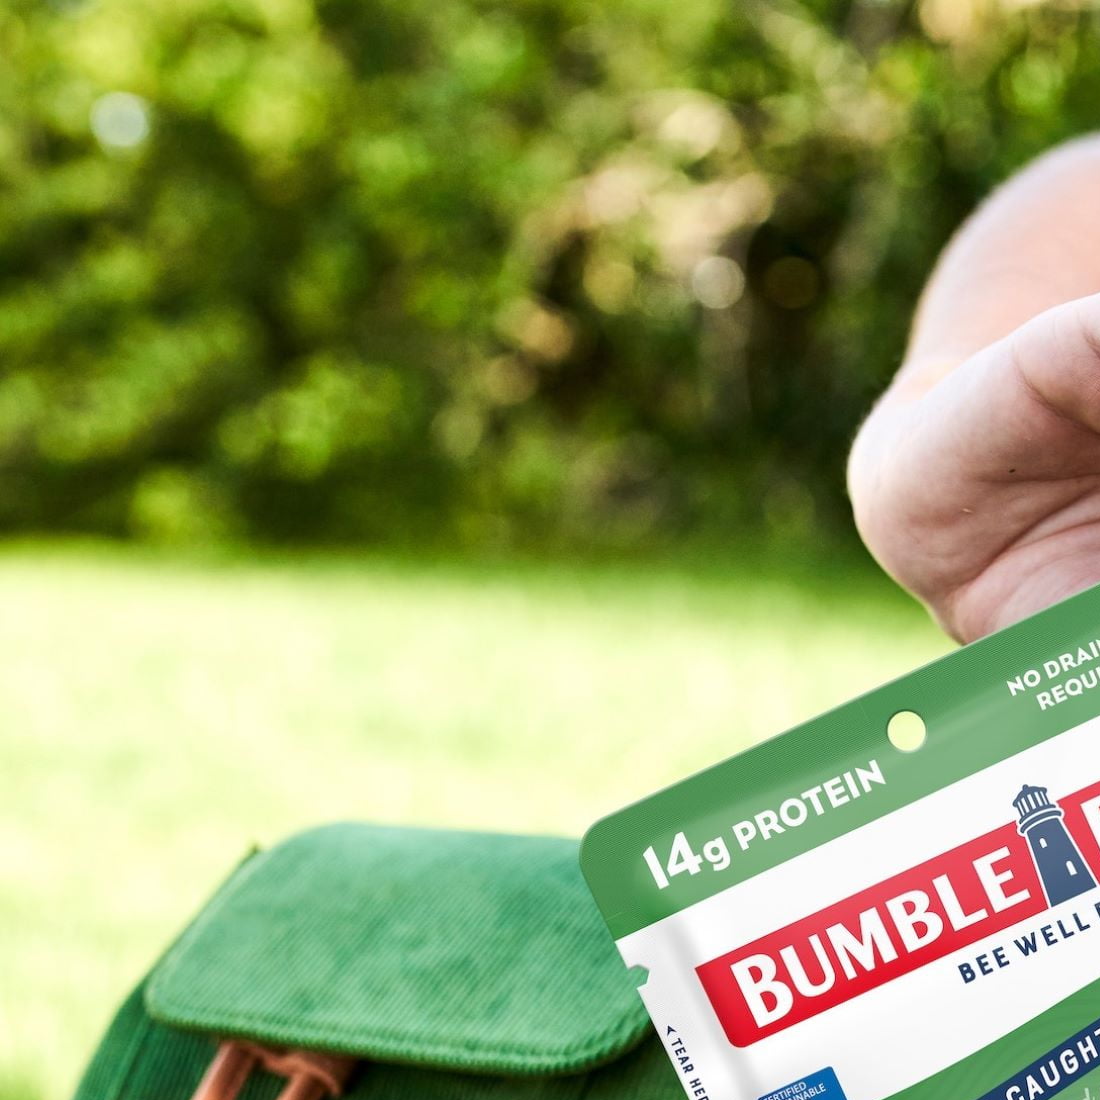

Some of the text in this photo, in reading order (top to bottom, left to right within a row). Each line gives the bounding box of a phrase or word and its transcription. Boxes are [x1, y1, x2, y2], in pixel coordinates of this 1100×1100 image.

[1006, 669, 1041, 697] NO
[643, 759, 887, 890] 14g PROTEIN
[730, 846, 1031, 1029] BUMBLE
[958, 946, 1010, 984] BEE
[1014, 912, 1091, 956] WELL
[671, 1037, 695, 1075] TEAR
